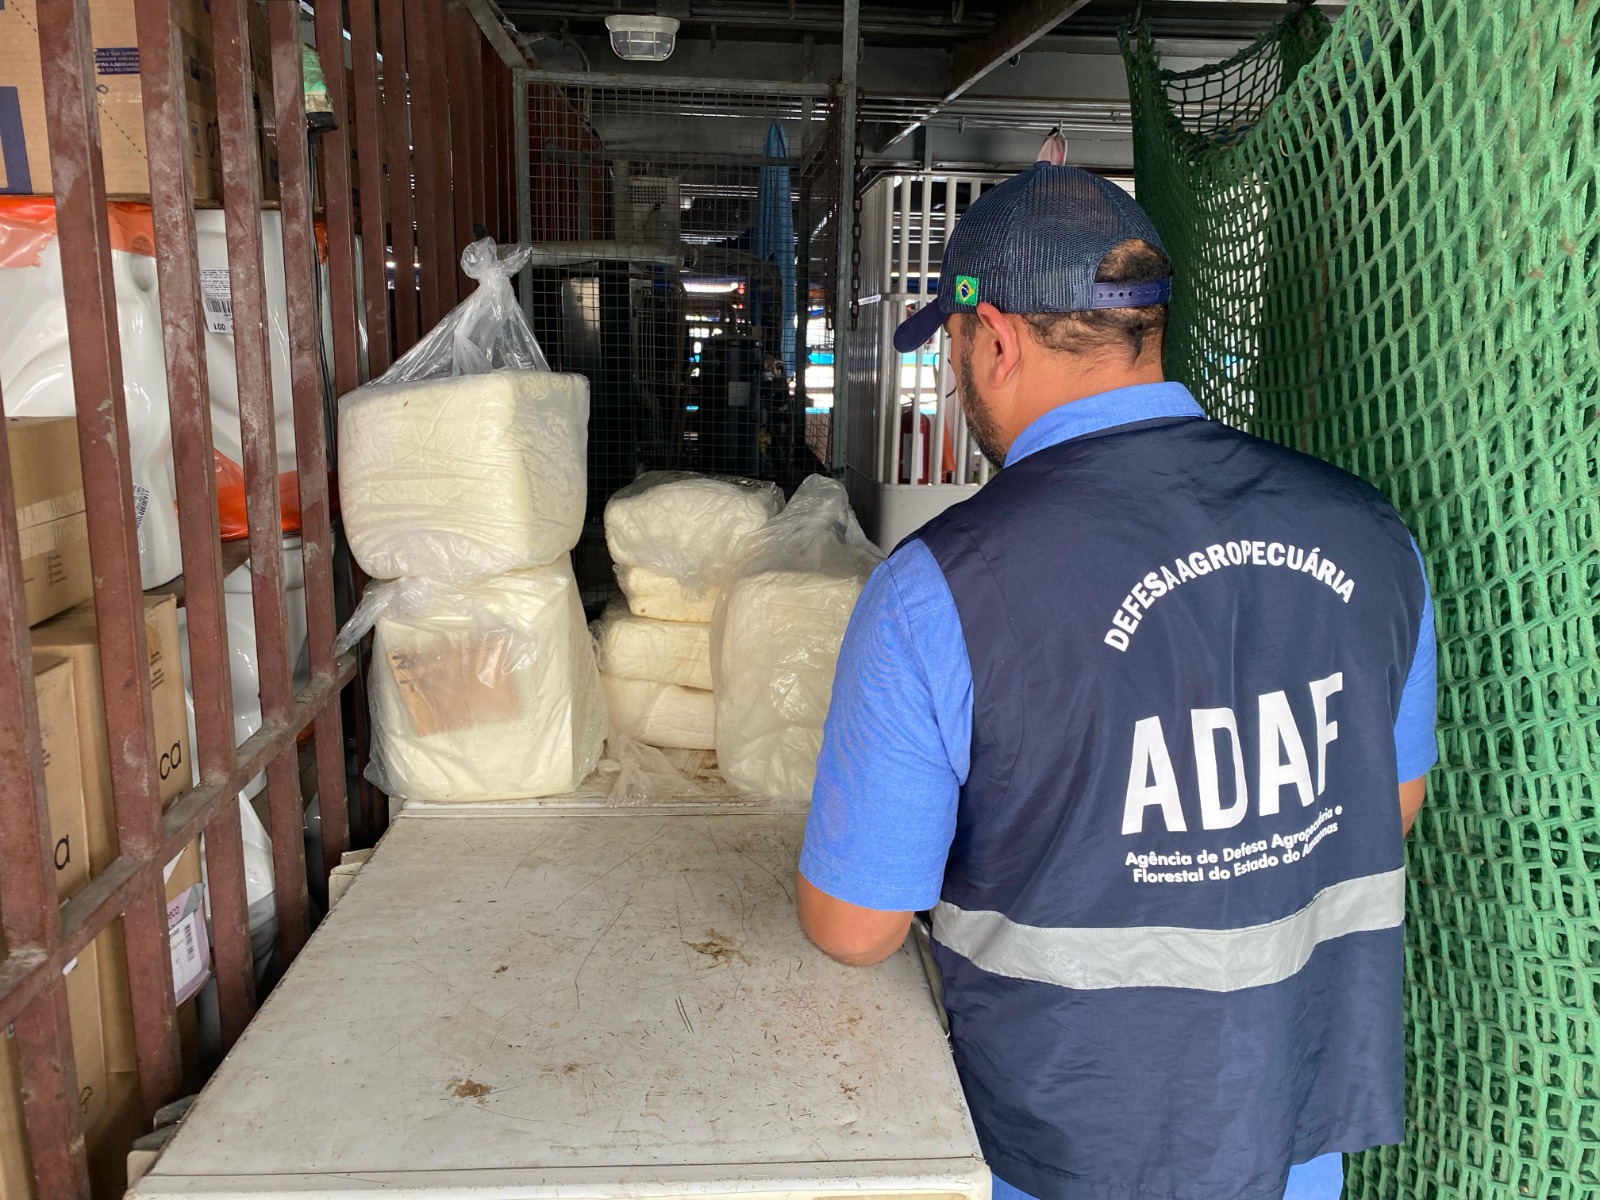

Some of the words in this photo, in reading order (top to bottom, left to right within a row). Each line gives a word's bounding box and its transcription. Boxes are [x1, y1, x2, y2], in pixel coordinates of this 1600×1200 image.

[1121, 671, 1343, 836] ADAF
[1125, 851, 1192, 868] Agência
[1197, 850, 1218, 864] de
[1223, 837, 1268, 863] Defesa
[1271, 807, 1333, 849] Agropecuária
[1334, 805, 1343, 816] e
[1133, 868, 1204, 883] Florestal
[1209, 867, 1231, 881] do
[1234, 853, 1278, 877] Estado
[1282, 849, 1300, 864] do
[1301, 822, 1338, 857] Amazonas
